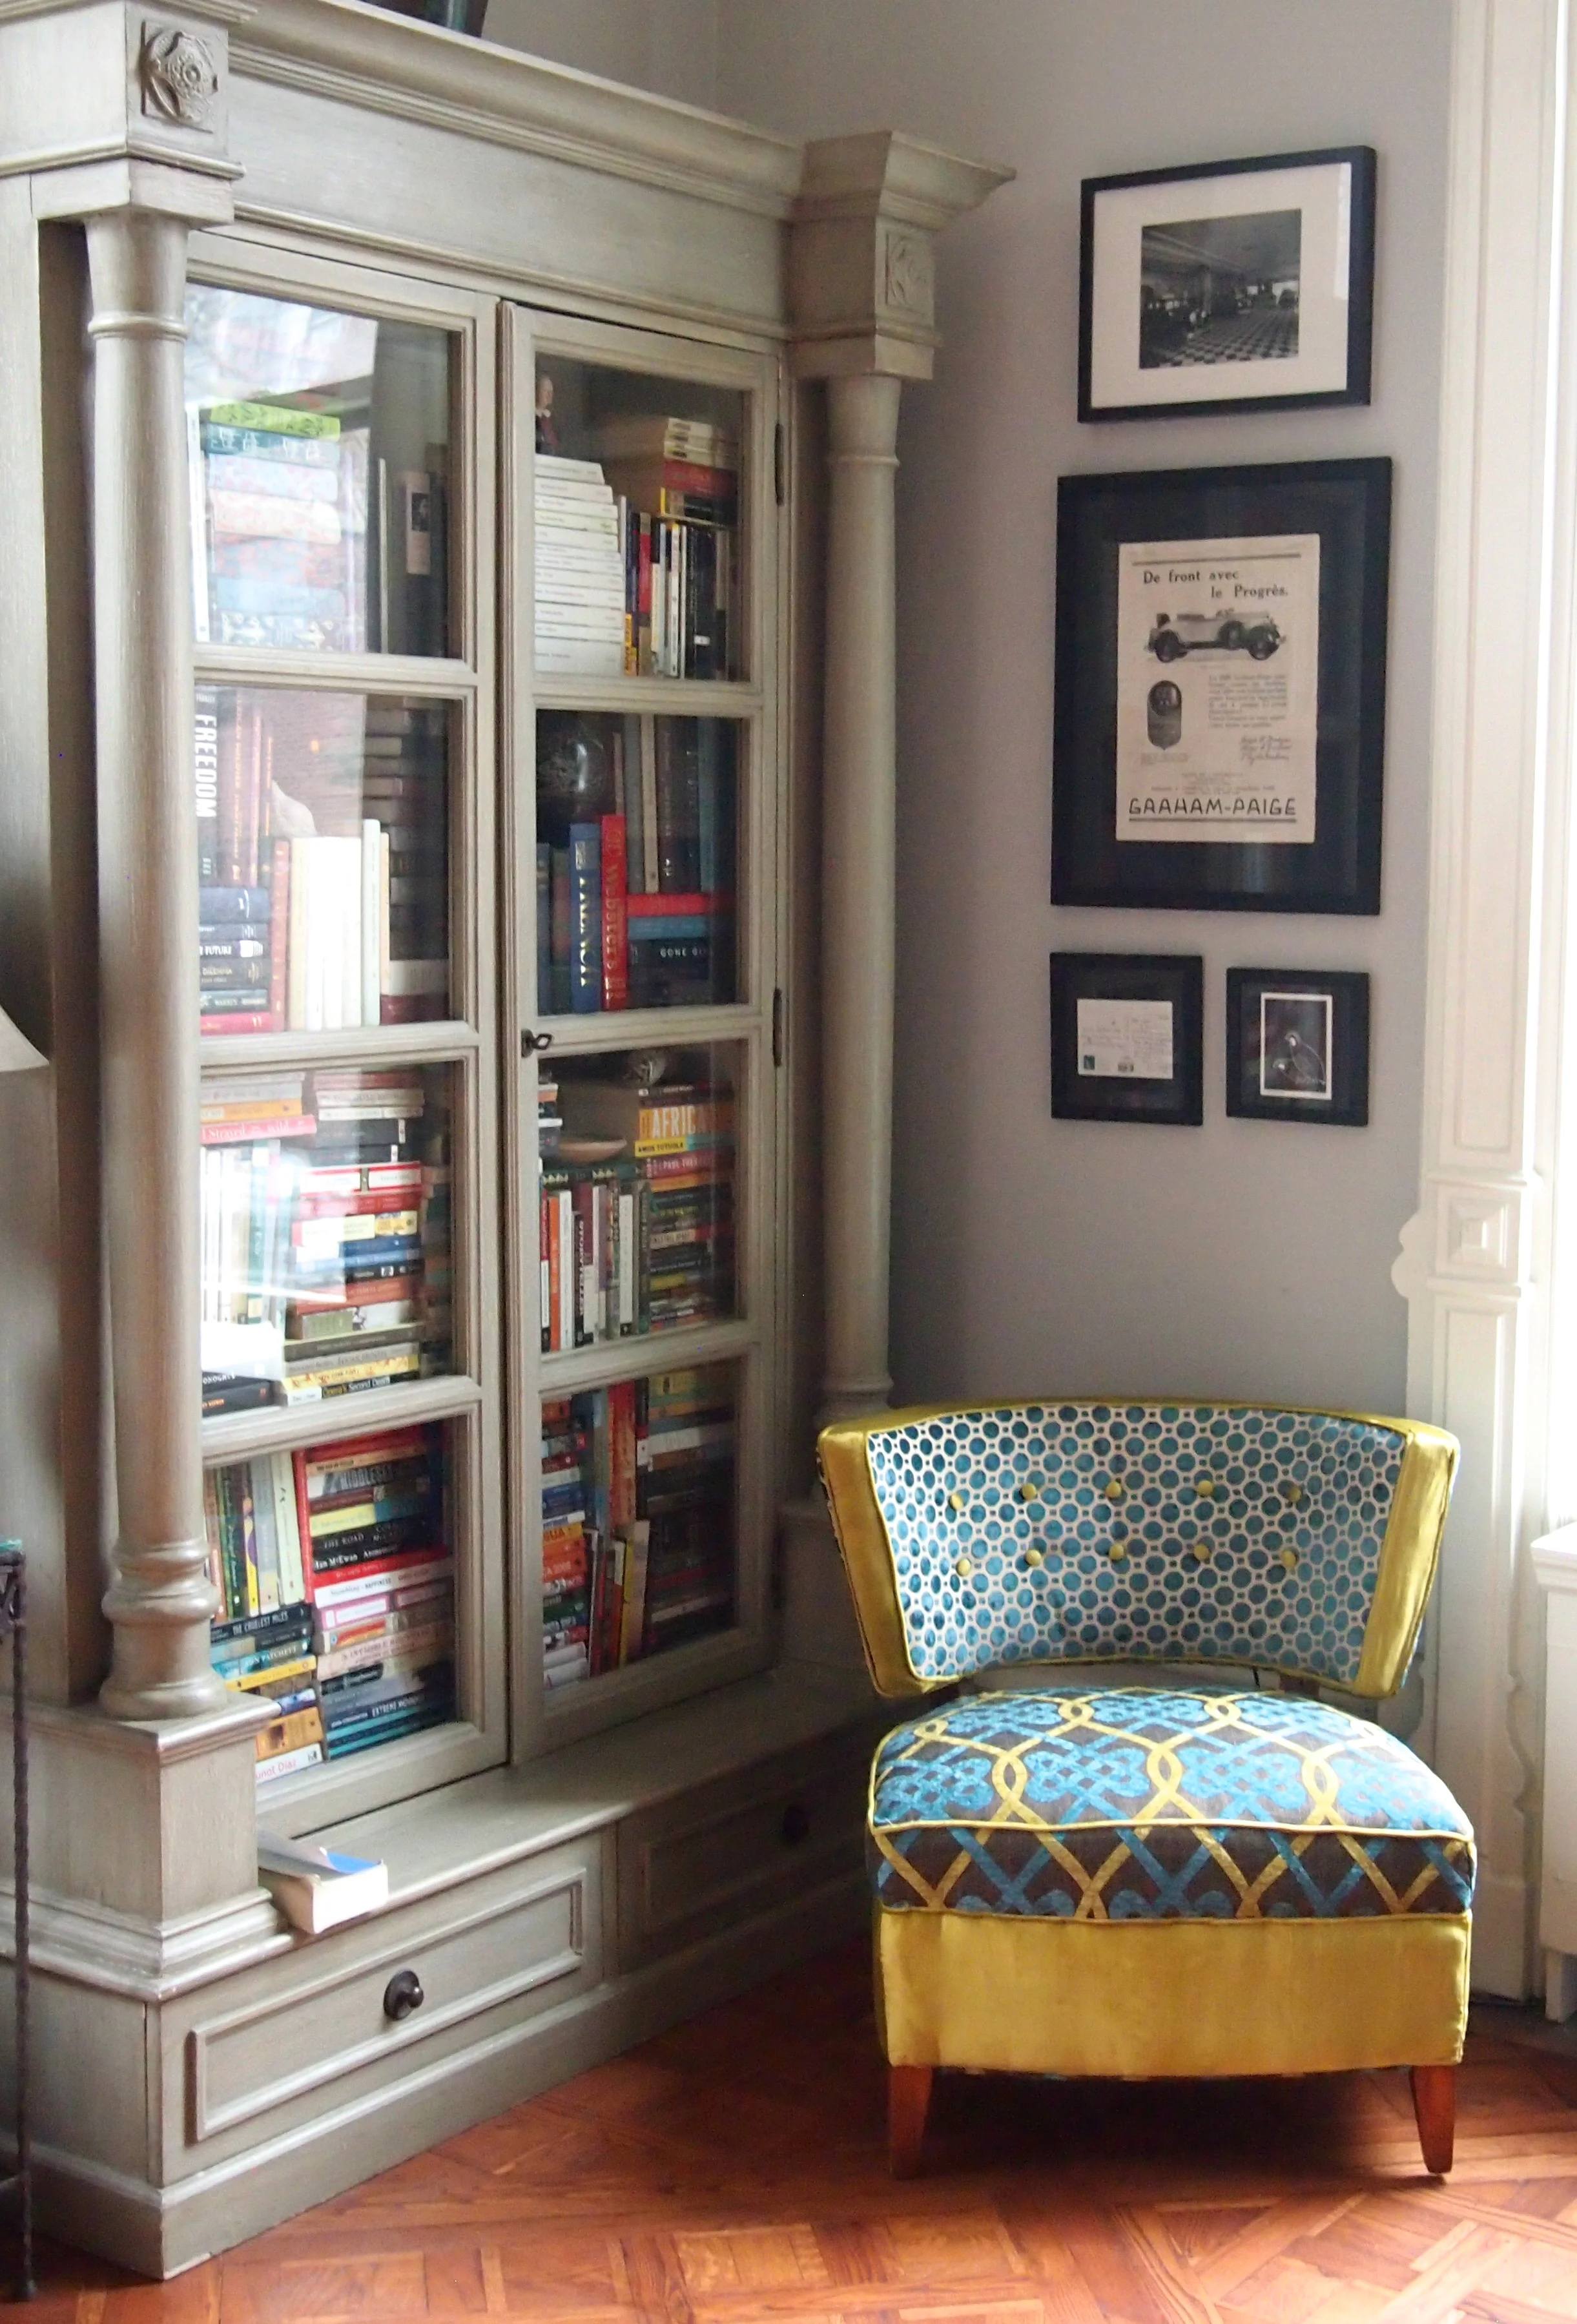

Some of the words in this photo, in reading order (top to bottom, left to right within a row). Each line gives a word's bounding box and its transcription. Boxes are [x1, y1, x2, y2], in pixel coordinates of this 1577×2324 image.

[1143, 570, 1160, 585] De
[1168, 569, 1201, 583] front
[1209, 570, 1240, 580] avec
[1211, 586, 1222, 599] le
[195, 714, 217, 818] FREEDOM
[1128, 797, 1297, 816] GRAHAM-PAIGE
[659, 947, 687, 959] GONE
[652, 1104, 707, 1139] AFRICA
[208, 1122, 245, 1141] Strayed
[265, 1120, 289, 1133] wild
[348, 1380, 371, 1392] Second
[324, 1540, 339, 1550] THE
[342, 1533, 364, 1546] ROAD
[256, 1767, 276, 1779] unot
